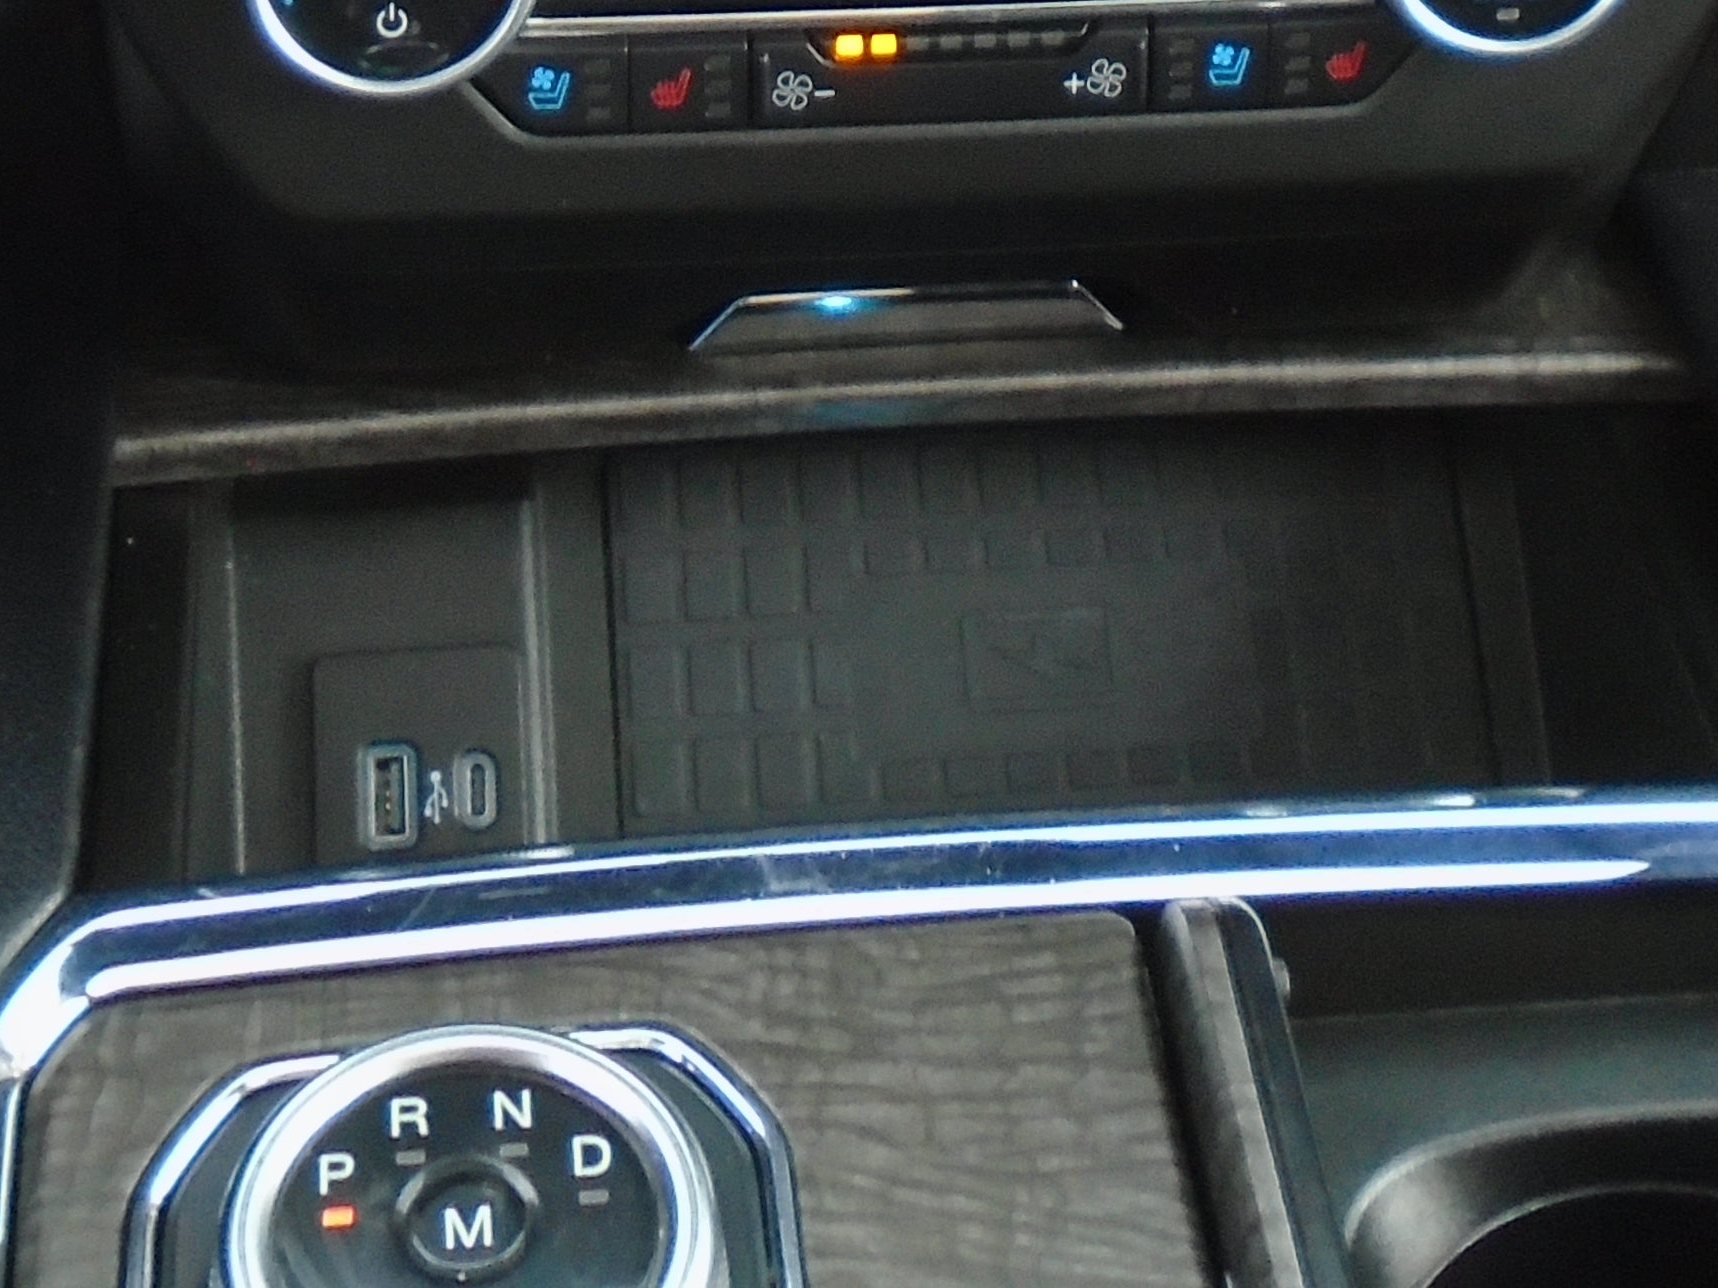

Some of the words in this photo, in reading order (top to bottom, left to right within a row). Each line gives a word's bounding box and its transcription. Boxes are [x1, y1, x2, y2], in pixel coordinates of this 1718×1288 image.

[389, 1096, 429, 1138] R
[492, 1088, 533, 1131] N
[318, 1152, 355, 1196] P
[571, 1134, 612, 1177] D
[443, 1204, 493, 1250] M
